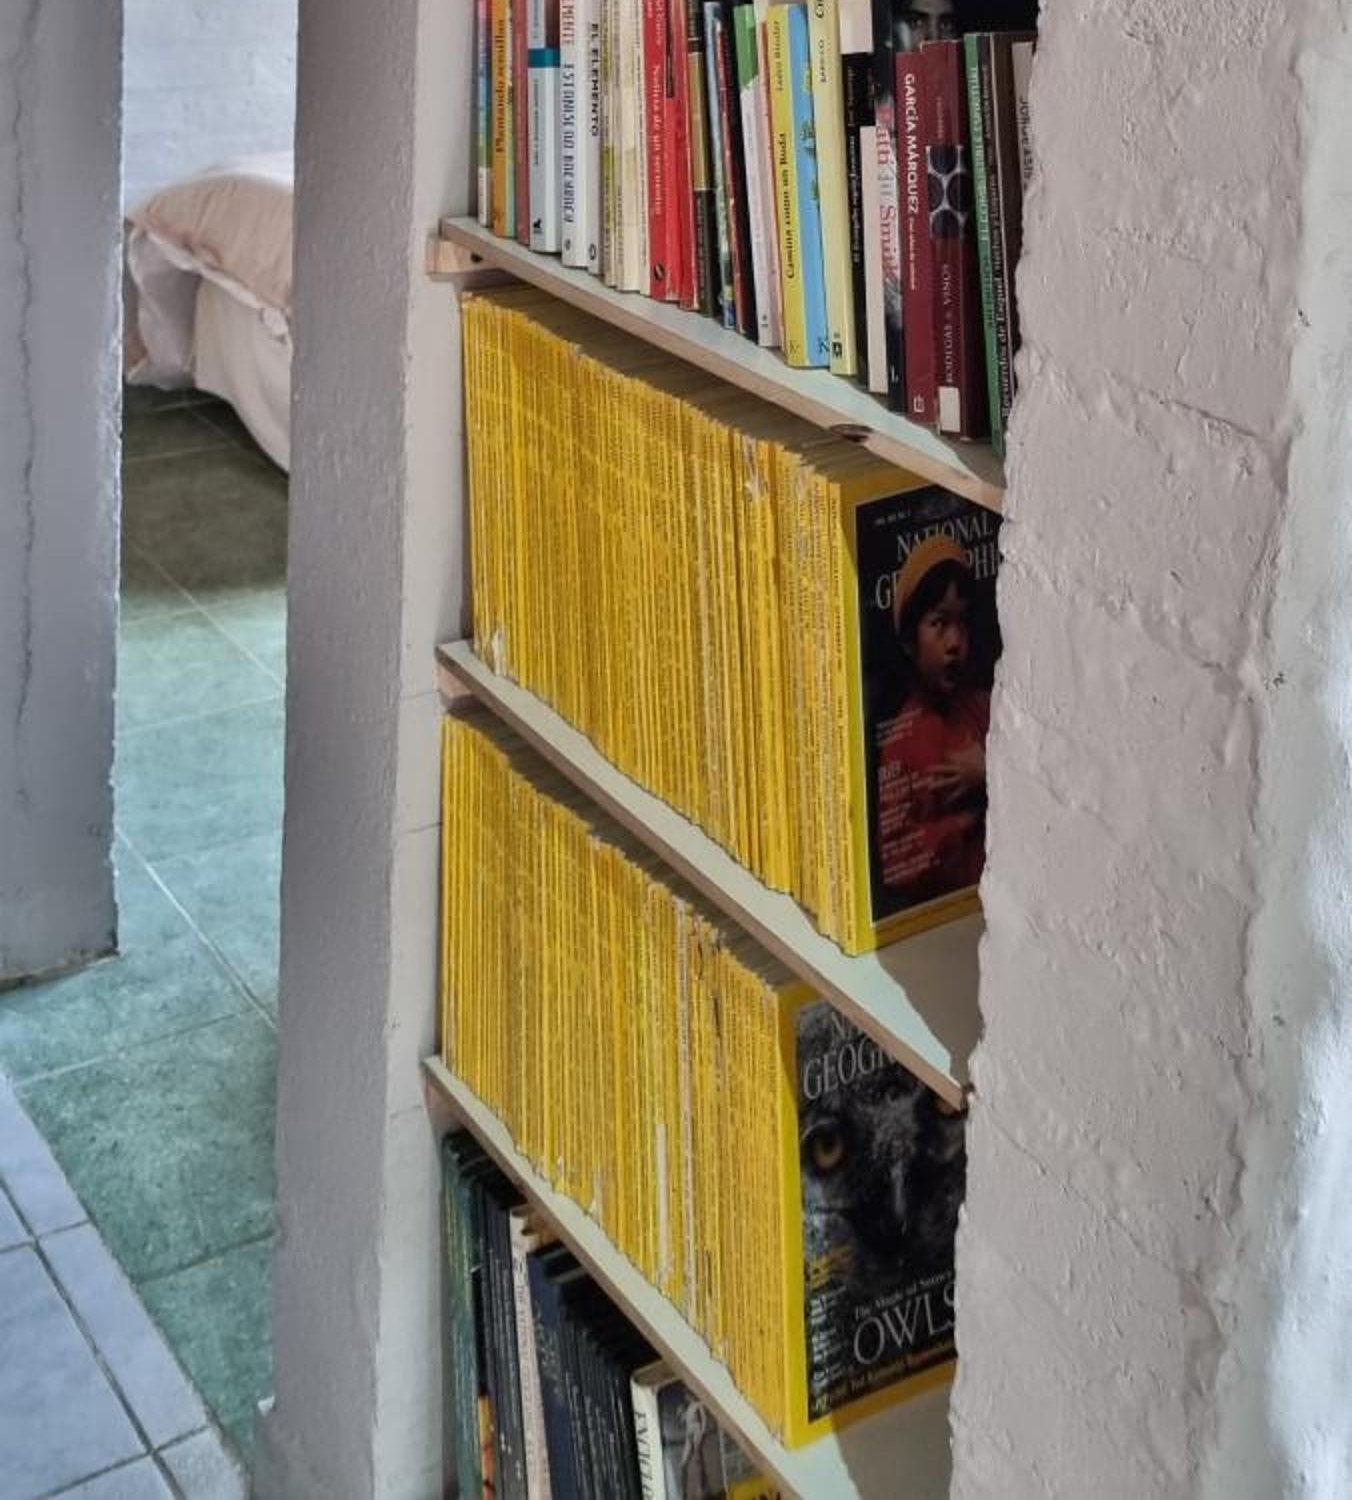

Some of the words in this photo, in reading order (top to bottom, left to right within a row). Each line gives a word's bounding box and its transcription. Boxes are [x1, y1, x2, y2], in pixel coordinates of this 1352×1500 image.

[495, 21, 505, 81] semillas
[591, 23, 599, 41] EL
[590, 48, 599, 136] ELEMENTO
[652, 65, 662, 111] Noticia
[904, 73, 918, 133] GARCÍA
[494, 83, 505, 155] Plantando
[653, 116, 662, 130] de
[778, 134, 788, 166] Buda
[907, 136, 920, 214] MÁRQUEZ
[782, 169, 788, 187] un
[784, 229, 794, 280] Camina
[942, 265, 953, 307] VINOS
[944, 326, 955, 385] BODEGAS
[998, 327, 1007, 344] de
[999, 348, 1012, 420] Recuerdos
